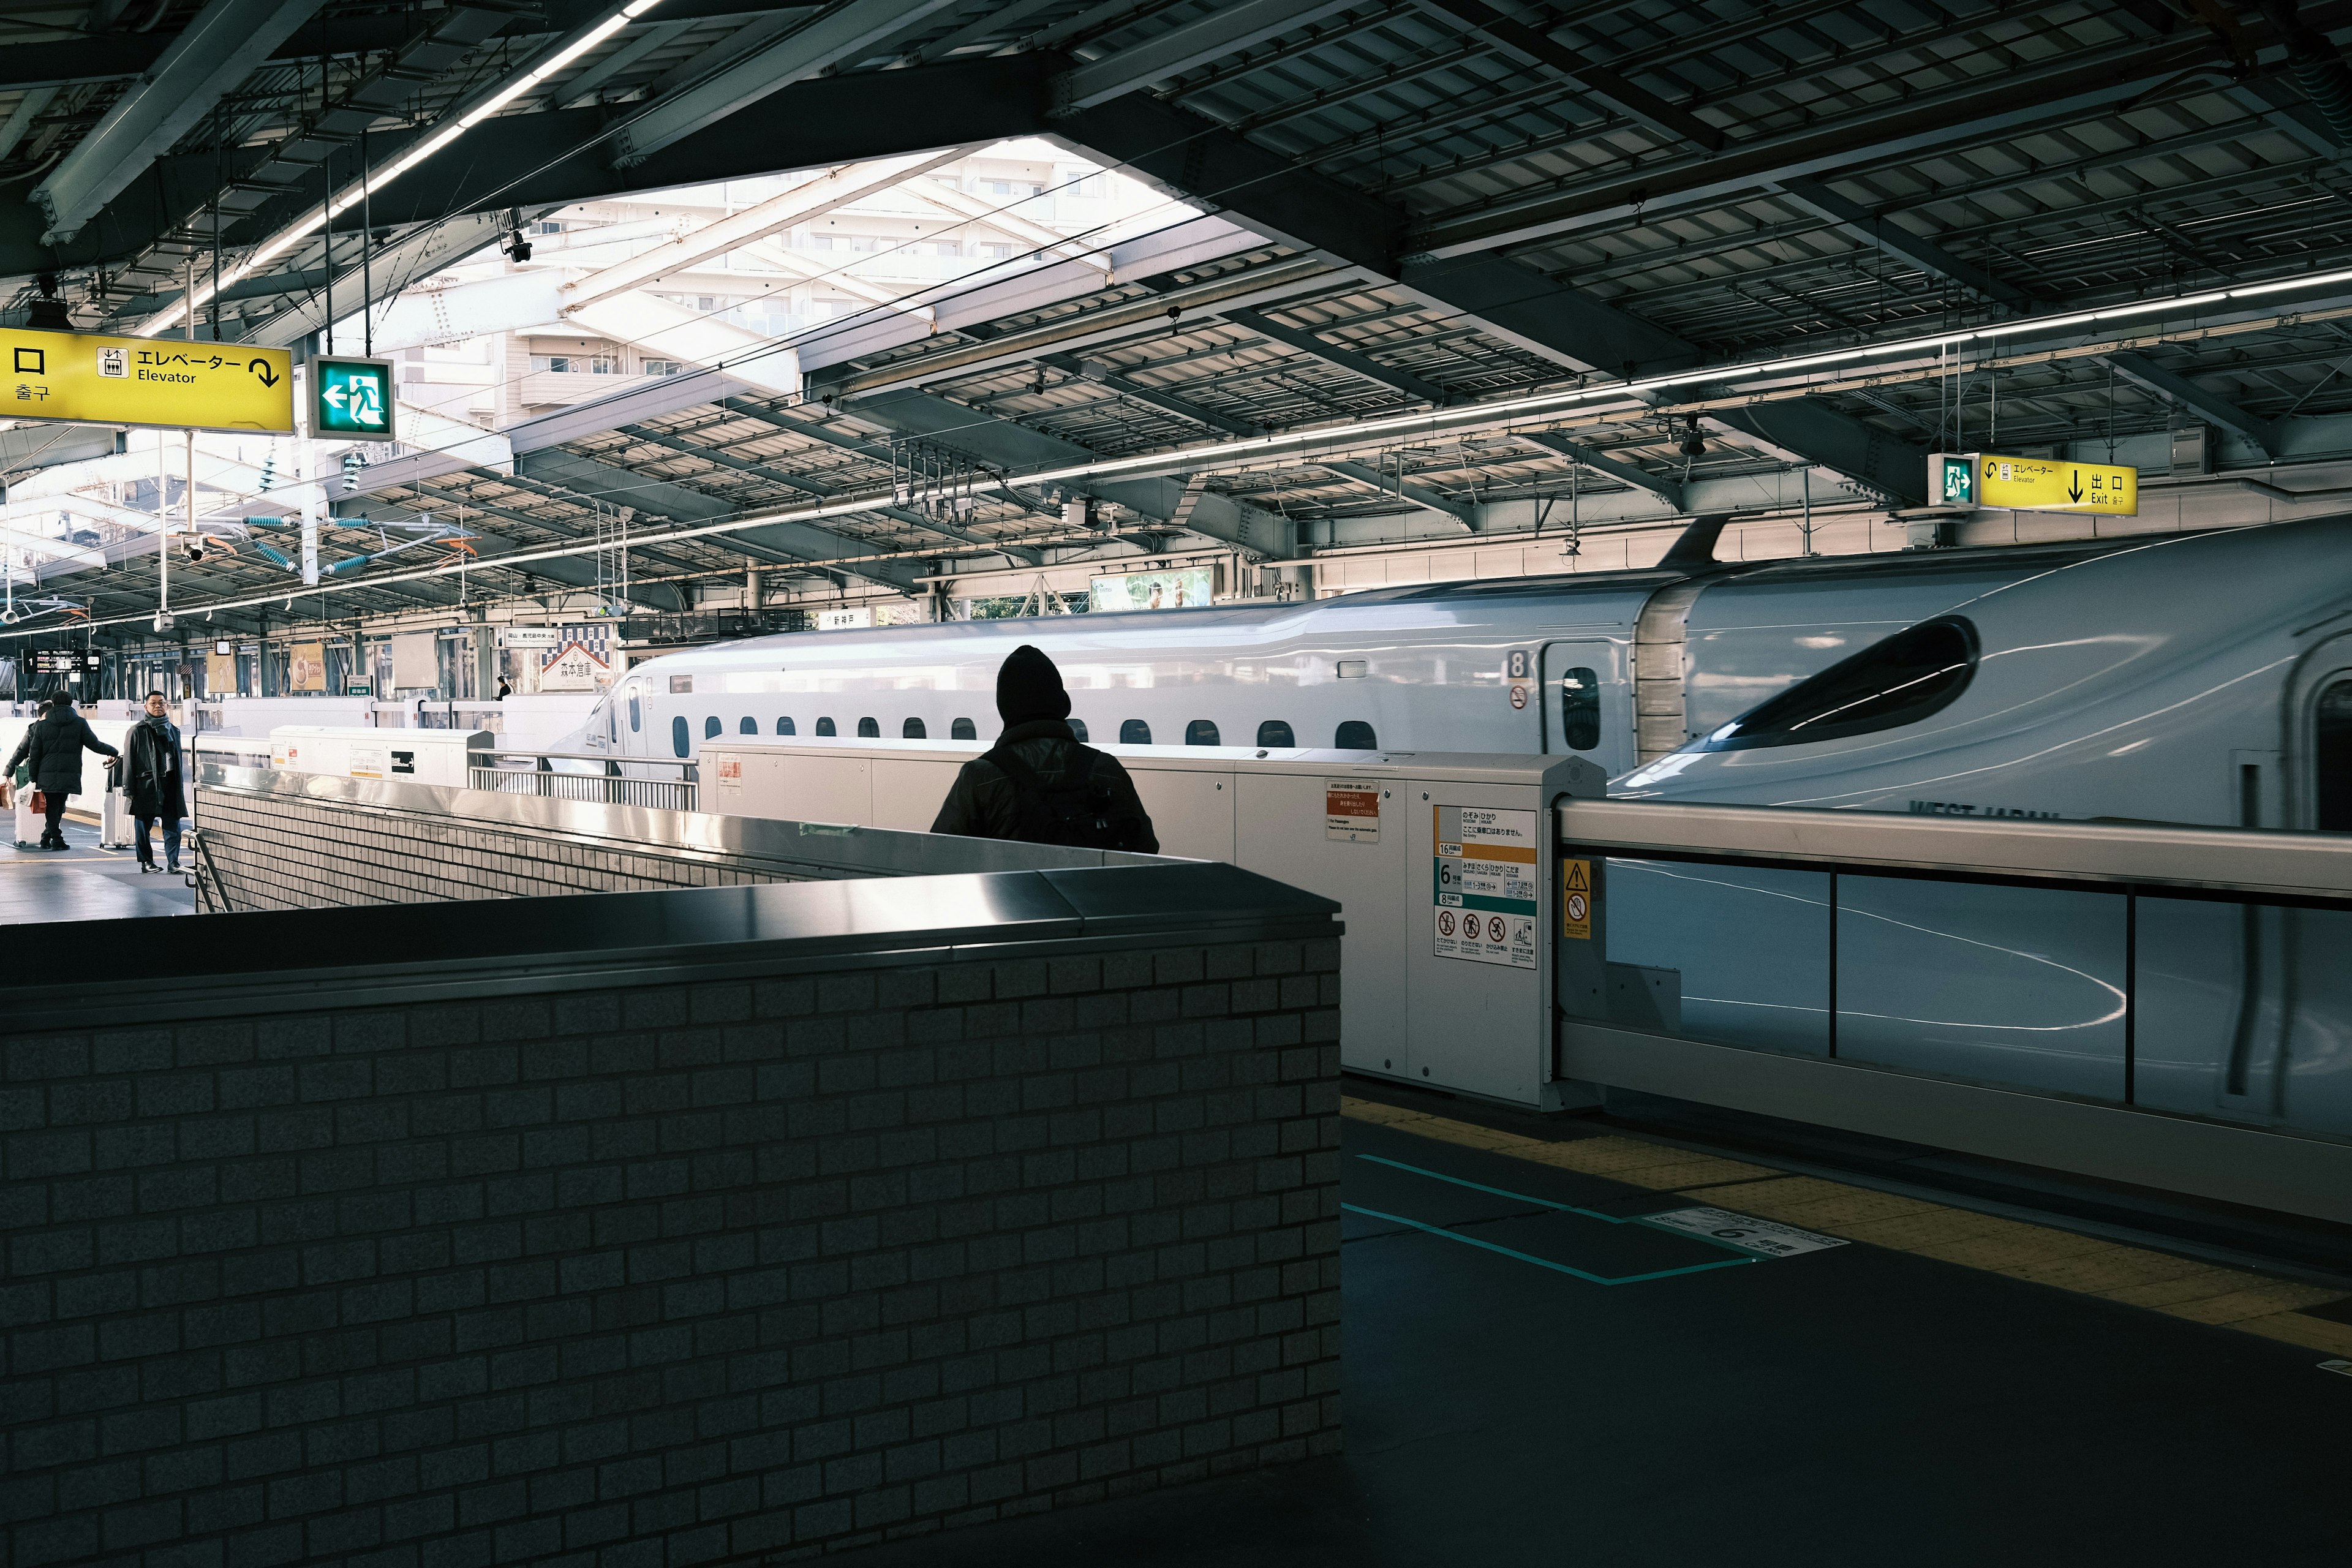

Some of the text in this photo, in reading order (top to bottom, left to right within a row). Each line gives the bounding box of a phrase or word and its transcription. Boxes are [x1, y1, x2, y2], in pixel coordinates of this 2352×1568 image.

[137, 350, 241, 370] エレベーター
[138, 369, 197, 383] Elevator
[15, 384, 50, 401] 출구
[2014, 464, 2053, 475] エレベーター
[2092, 473, 2122, 491] 出口
[2092, 492, 2124, 505] Exit 출구
[834, 615, 854, 625] 新神戸
[560, 661, 591, 677] 森本倉庫
[1511, 652, 1525, 677] 8
[1440, 844, 1449, 854] 16
[1441, 864, 1450, 884] 6
[1442, 894, 1447, 904] 8
[1711, 1229, 1799, 1251] 6 号車
